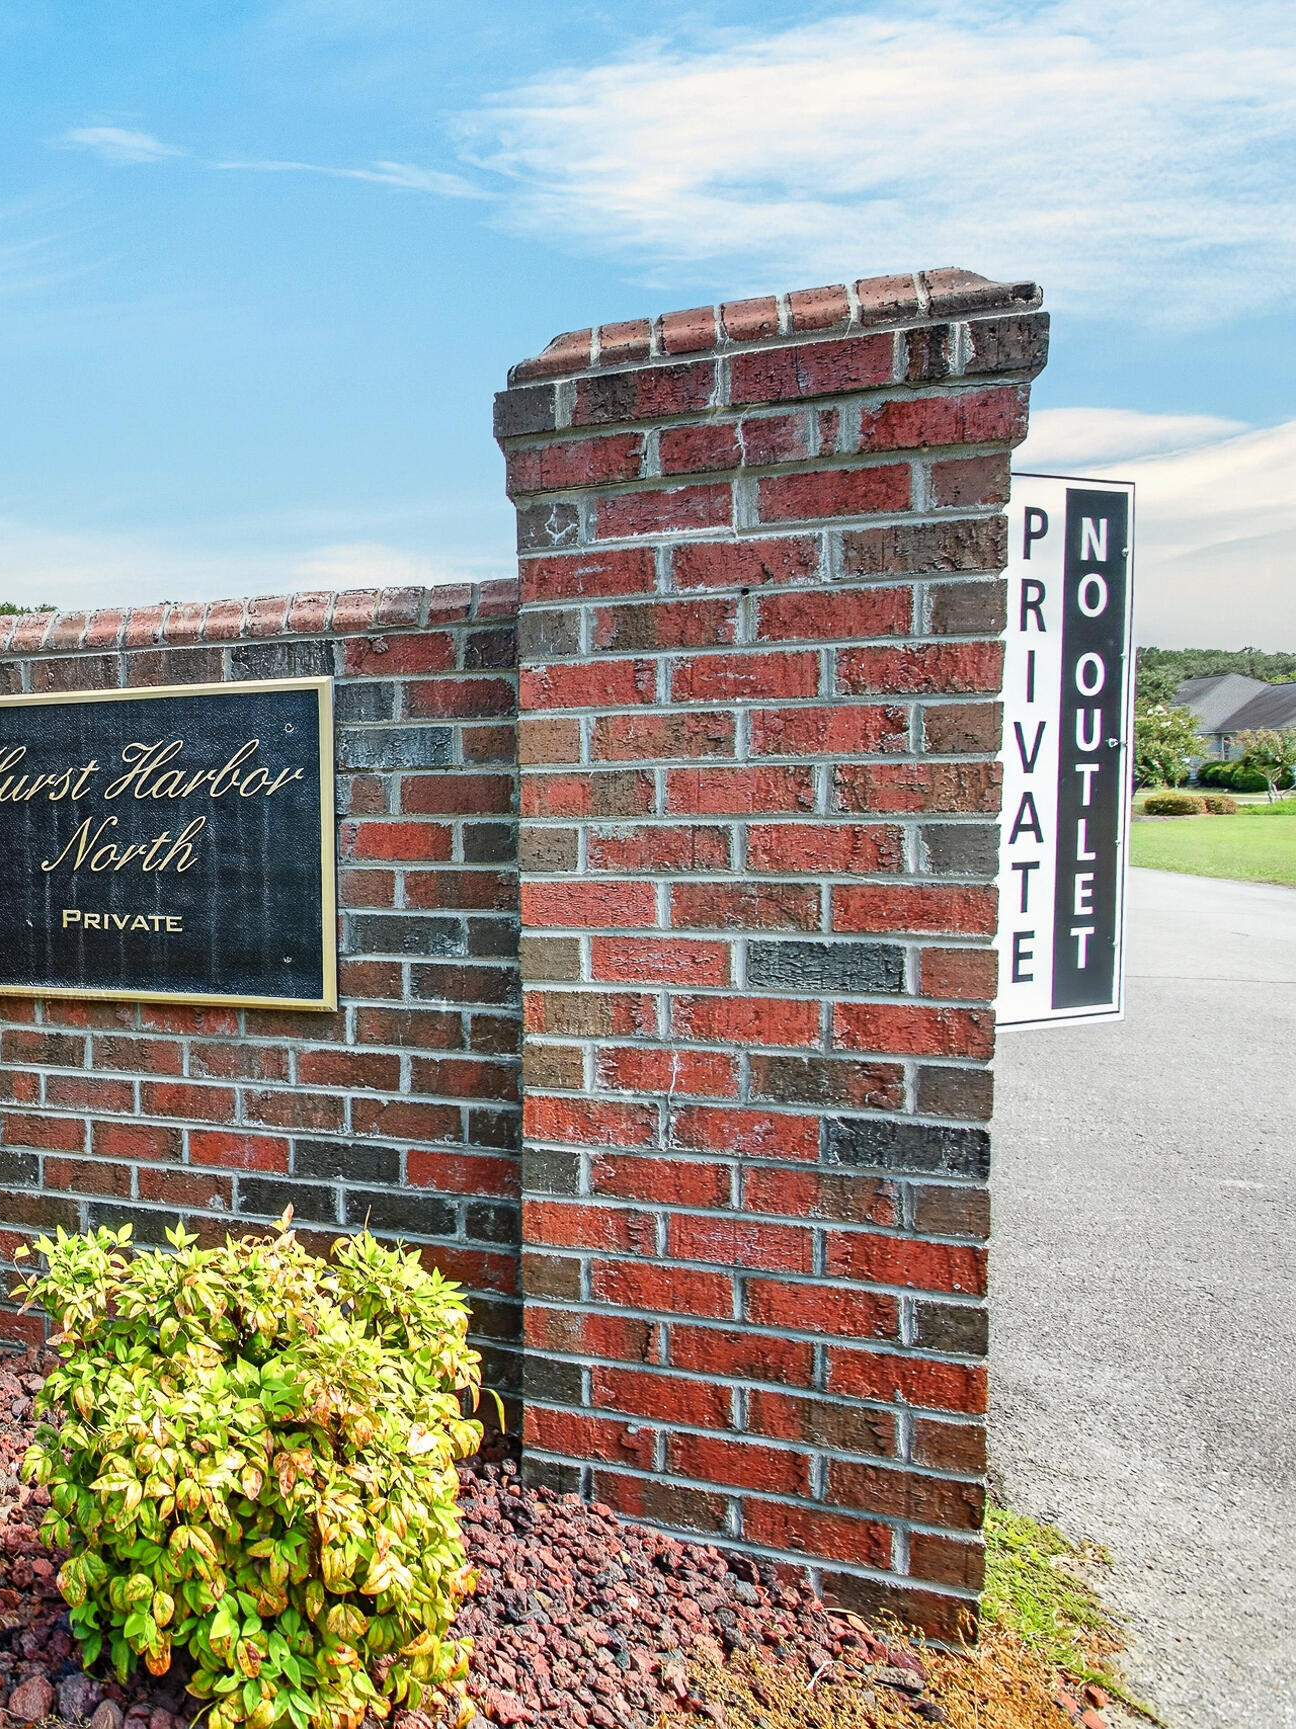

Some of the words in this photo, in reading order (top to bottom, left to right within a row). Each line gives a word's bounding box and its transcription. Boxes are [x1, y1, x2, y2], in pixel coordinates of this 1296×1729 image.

[1077, 516, 1109, 618] NO
[105, 738, 304, 800] Harbor
[1008, 505, 1049, 984] PRIVATE
[41, 815, 206, 873] North
[1070, 651, 1106, 969] OUTLET
